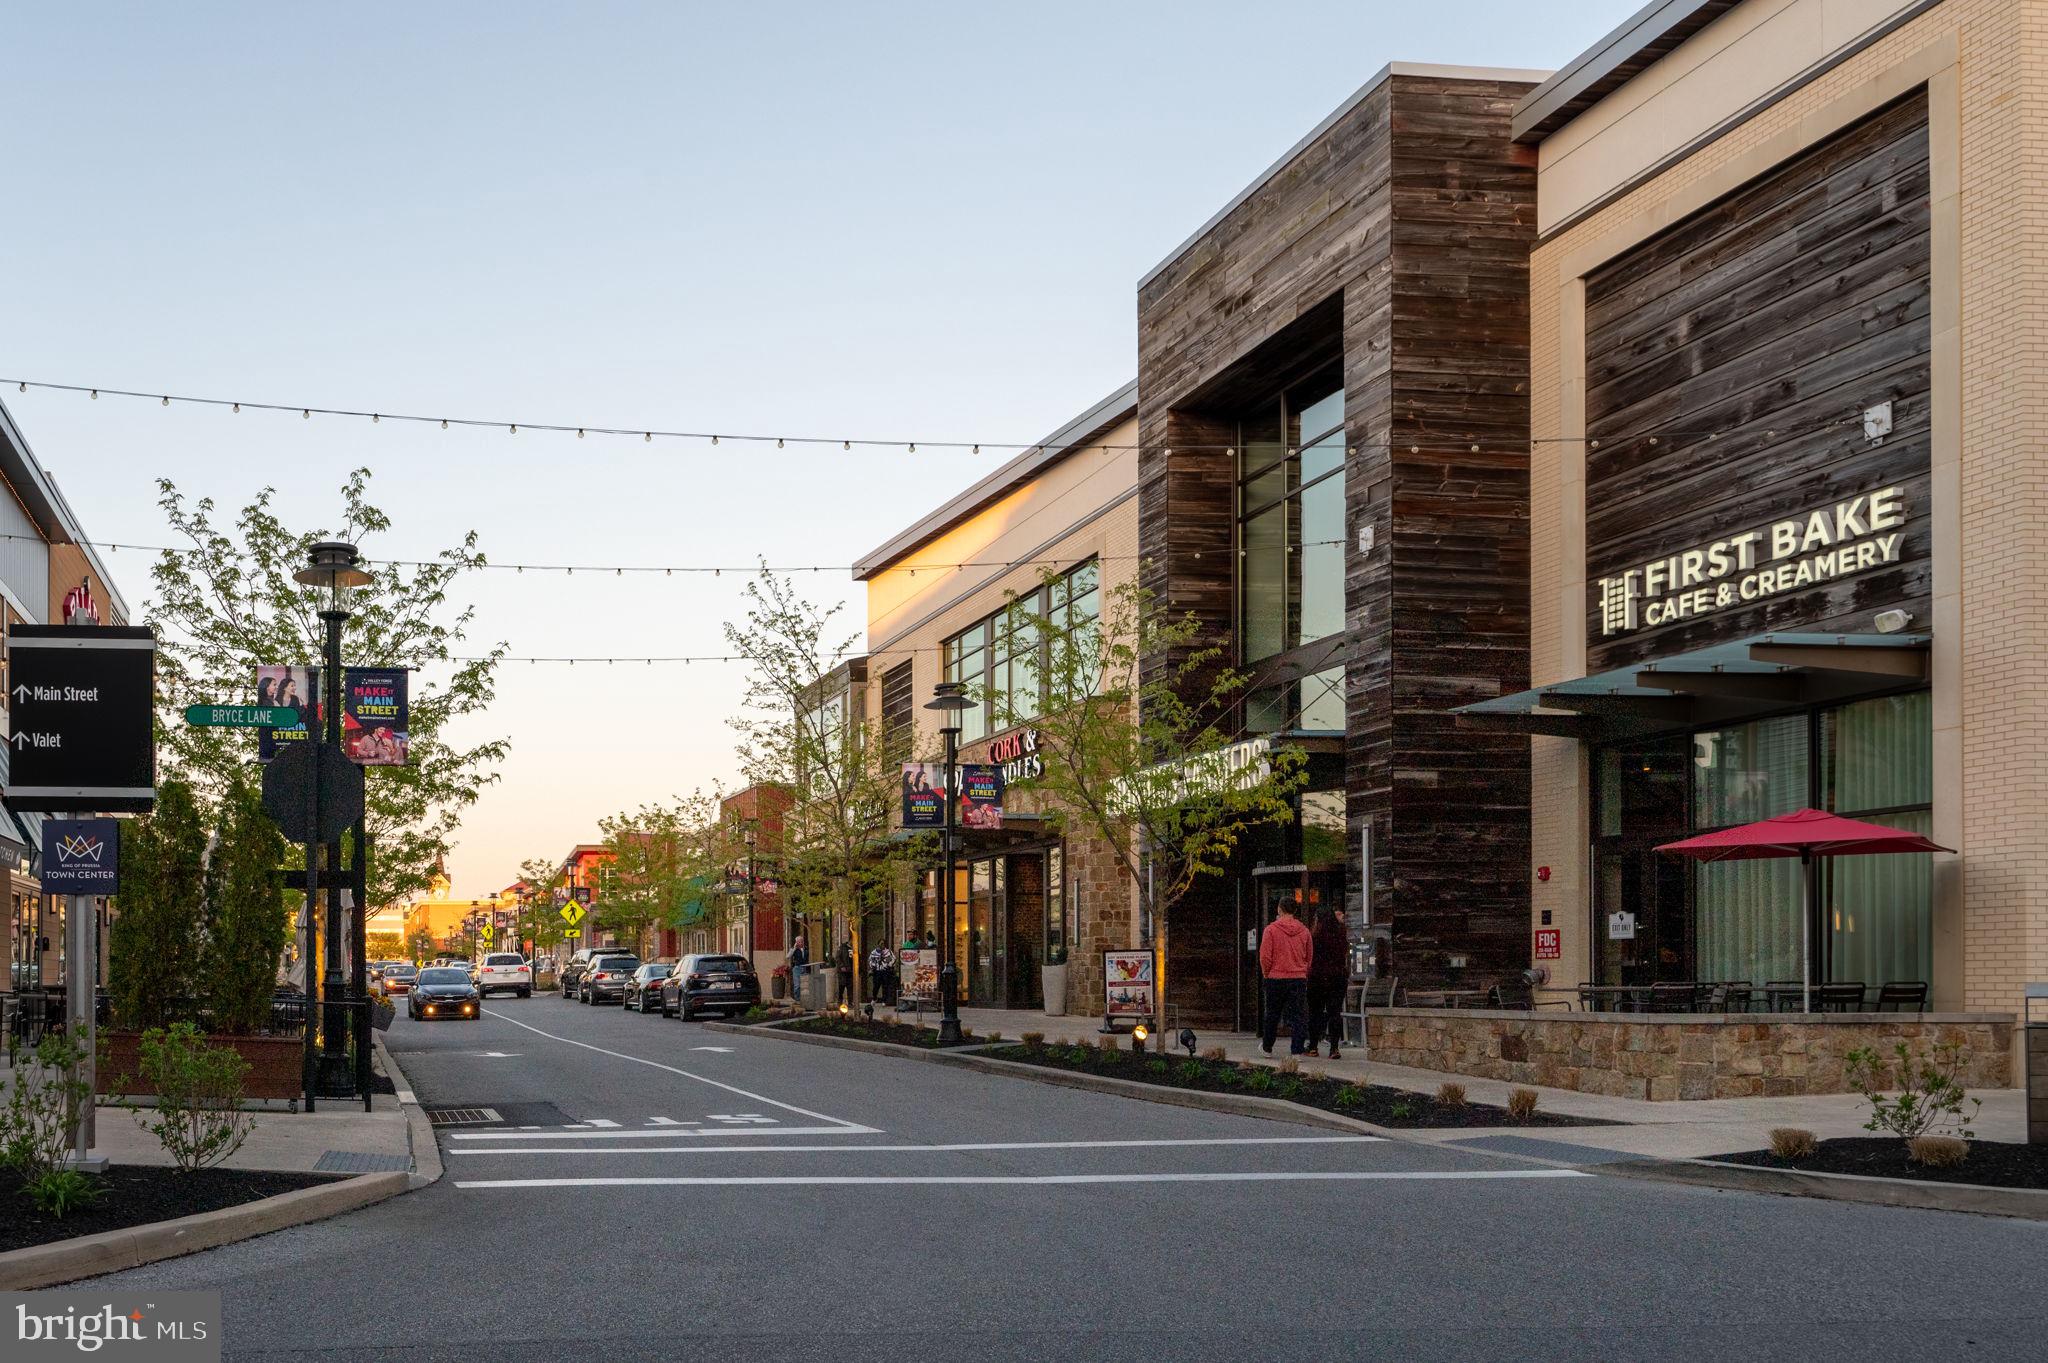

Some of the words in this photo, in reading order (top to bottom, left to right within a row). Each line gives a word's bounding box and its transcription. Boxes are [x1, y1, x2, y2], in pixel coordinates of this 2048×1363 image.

[1645, 532, 1759, 598] FIRST
[1771, 487, 1901, 560] BAKE
[1645, 588, 1713, 626] CAFE
[1715, 582, 1737, 607] &
[1739, 533, 1903, 600] CREAMERY
[34, 686, 61, 701] Main
[64, 686, 98, 701] Street
[354, 687, 388, 696] MAKE
[363, 696, 394, 706] MAIN
[212, 709, 244, 723] BRYCE
[247, 710, 273, 724] LANE
[356, 705, 399, 715] STREET
[32, 733, 61, 748] Valet
[987, 733, 1021, 764] CORK
[1025, 729, 1037, 752] &
[970, 789, 997, 797] STREET
[46, 871, 75, 879] TOWN
[77, 871, 115, 879] CENTER
[1538, 932, 1557, 947] FDC
